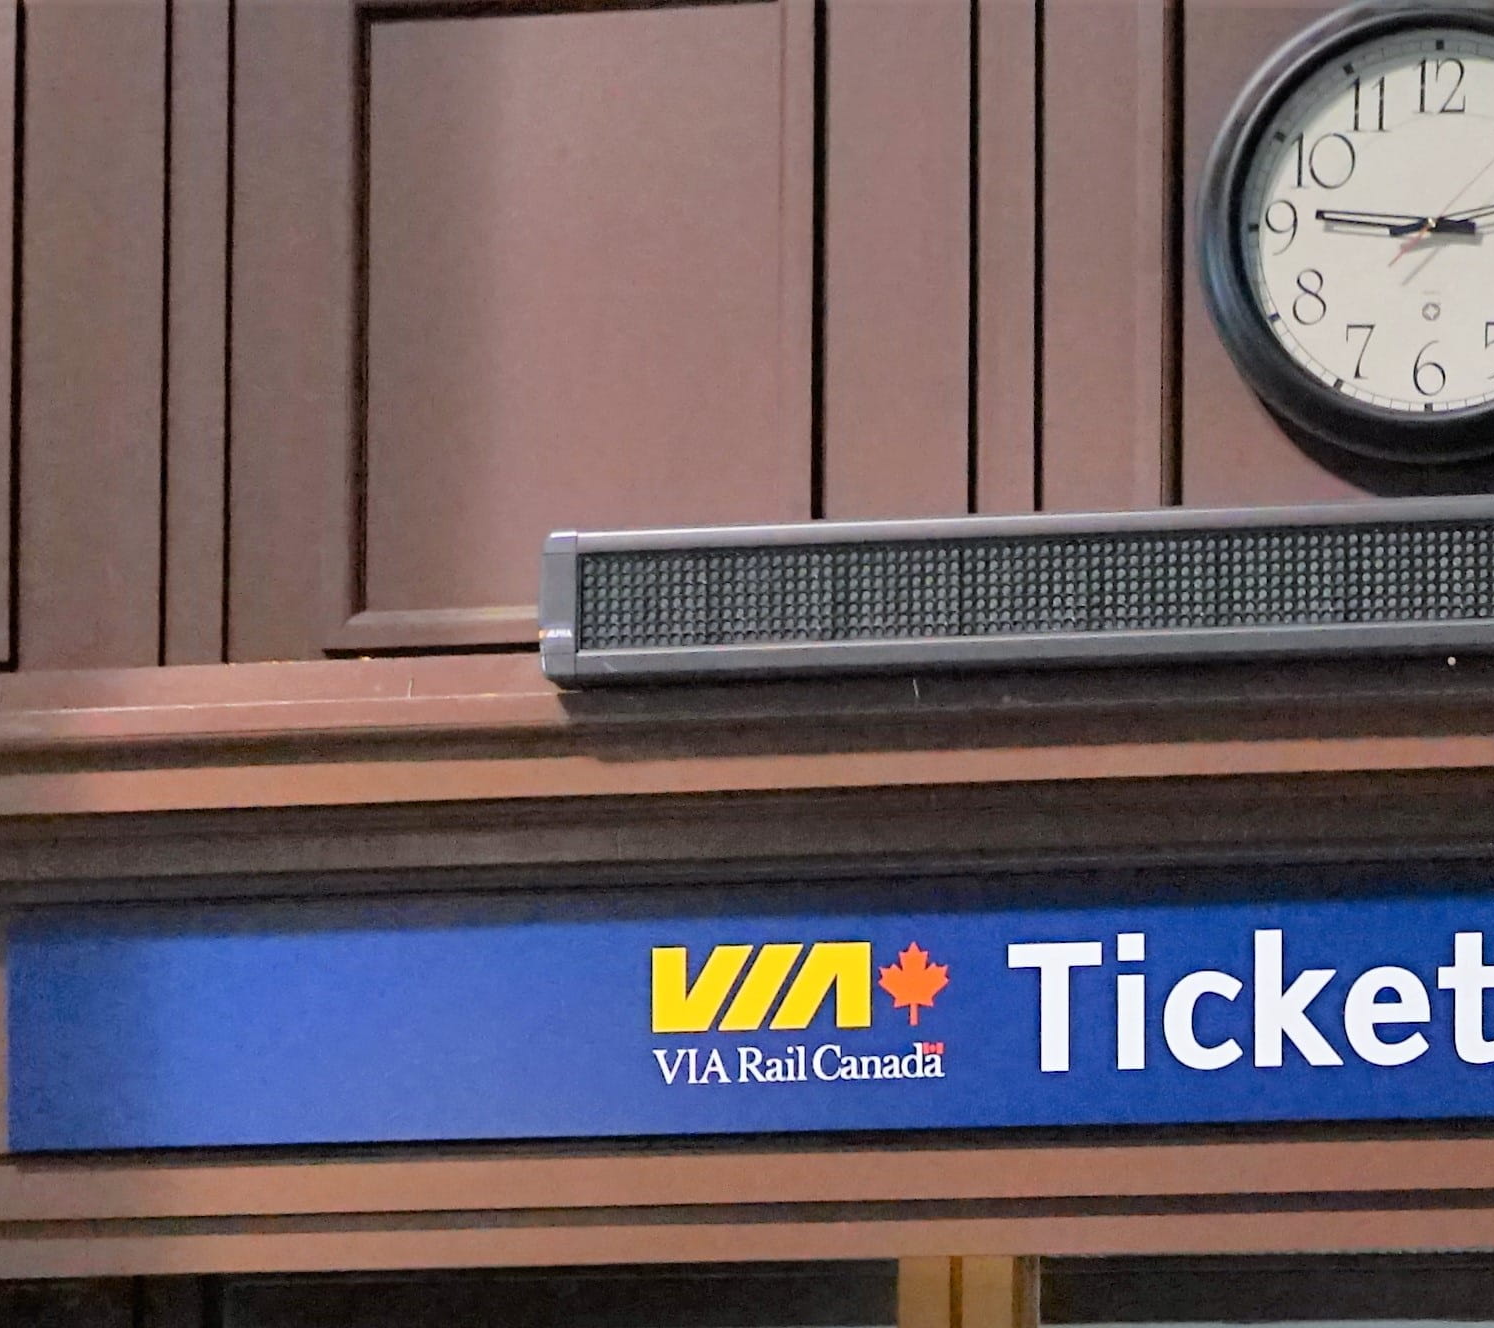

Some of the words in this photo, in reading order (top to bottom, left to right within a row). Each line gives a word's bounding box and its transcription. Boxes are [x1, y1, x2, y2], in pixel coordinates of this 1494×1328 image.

[1350, 76, 1389, 132] 11
[1413, 57, 1466, 114] 12
[1289, 132, 1356, 189] 10
[1264, 200, 1297, 256] 9
[1291, 268, 1327, 325] 8
[1345, 323, 1375, 379] 7
[1412, 341, 1446, 396] 6
[652, 941, 871, 1033] VIA
[653, 1049, 731, 1084] VIA
[737, 1045, 807, 1082] Rail
[812, 1041, 946, 1080] Canada
